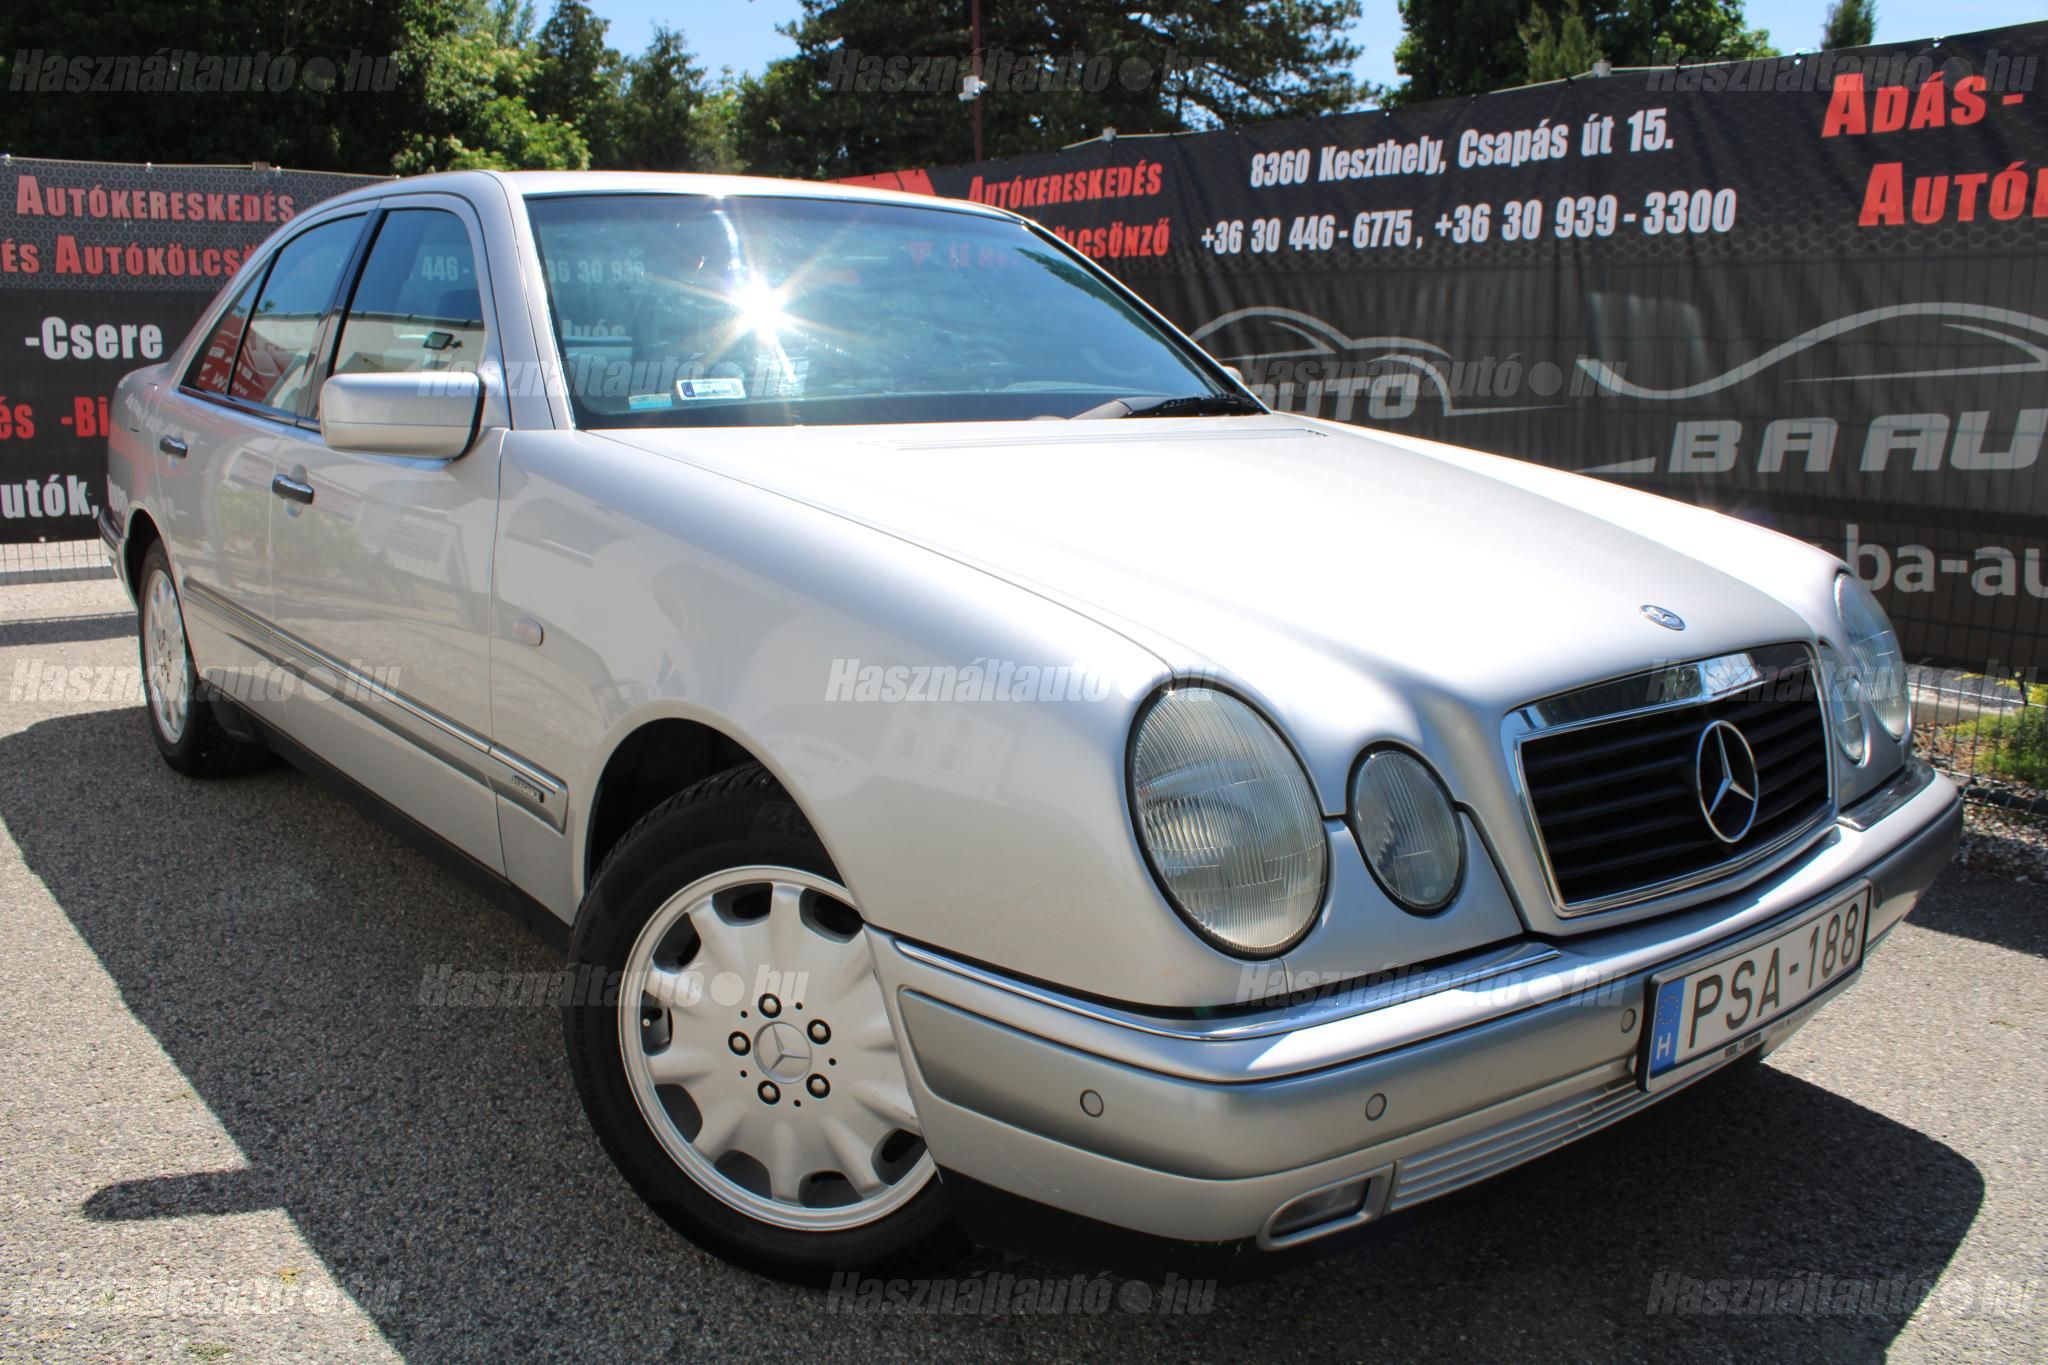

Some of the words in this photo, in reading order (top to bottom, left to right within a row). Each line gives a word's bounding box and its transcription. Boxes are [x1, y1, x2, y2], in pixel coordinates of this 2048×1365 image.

[1822, 71, 1987, 137] ADÁS
[1251, 148, 1311, 188] 8360
[1318, 138, 1446, 183] Keszthely,
[1458, 118, 1569, 168] Csapás
[1581, 113, 1615, 157] út
[1628, 108, 1674, 153] 15.
[16, 175, 295, 223] AUTÓKERESKEDÉS
[968, 160, 1162, 210] AUTÓKERESKEDÉS
[1201, 219, 1243, 255] +36
[1251, 217, 1281, 252] 30
[1434, 203, 1490, 243] +36
[1503, 199, 1543, 241] 30
[2, 238, 39, 273] ÉS
[25, 316, 163, 360] -Csere
[1688, 903, 1859, 1049] PSA-188
[1656, 1032, 1672, 1061] H
